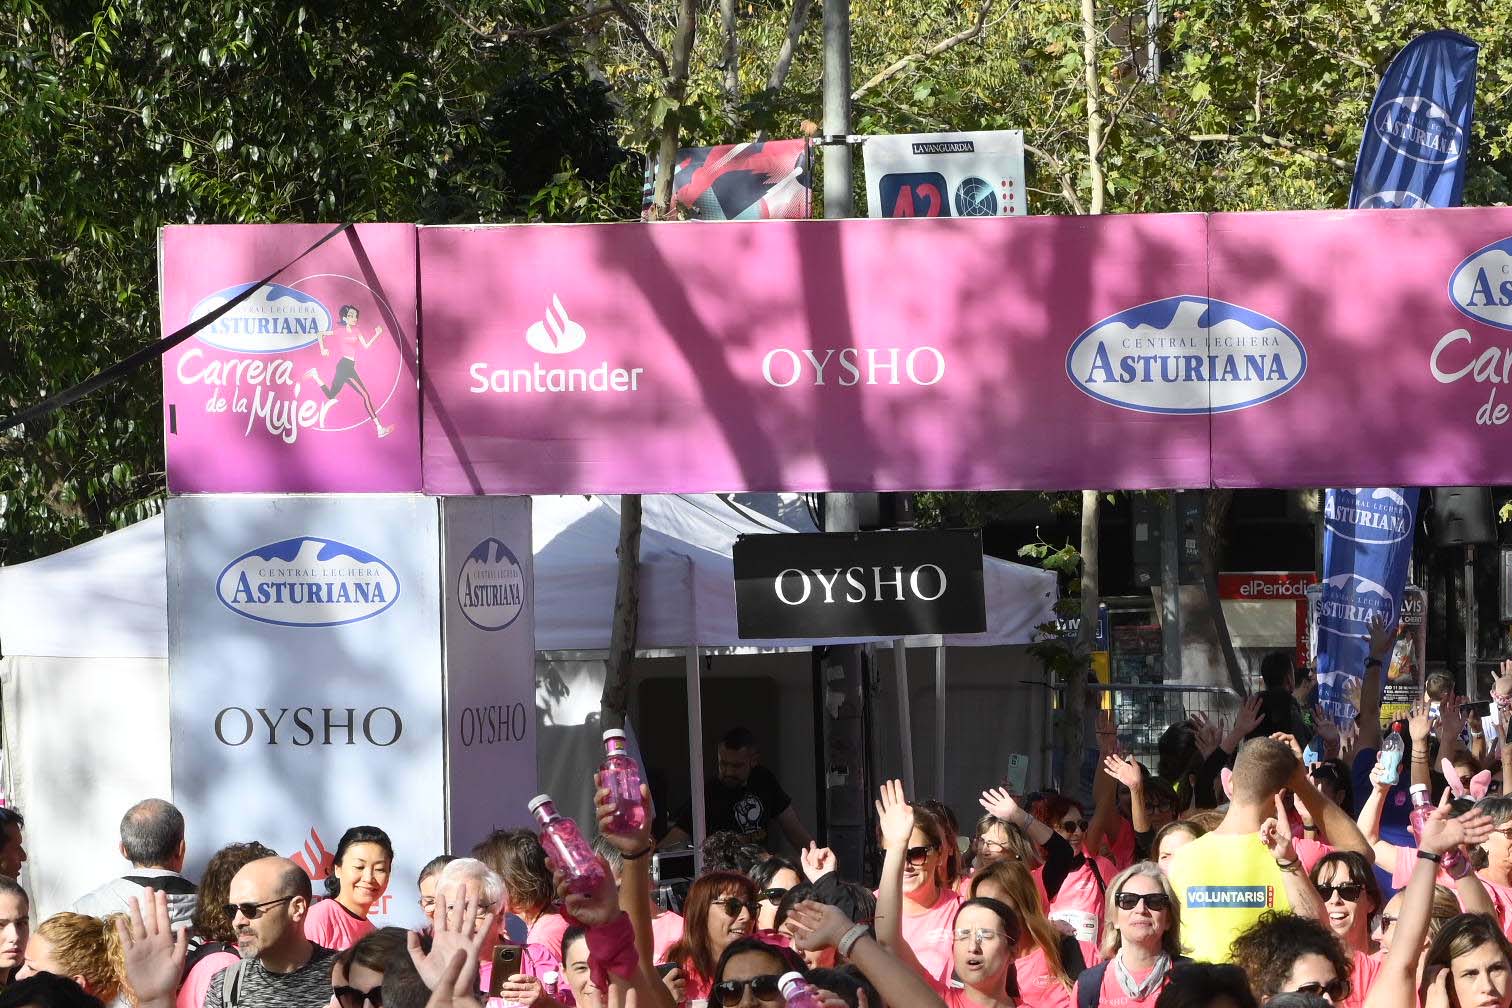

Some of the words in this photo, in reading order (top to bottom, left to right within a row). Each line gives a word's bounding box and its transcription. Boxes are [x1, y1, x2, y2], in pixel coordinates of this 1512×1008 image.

[1379, 107, 1458, 155] ASTURIANA
[1122, 337, 1200, 349] CENTRAL
[1204, 336, 1281, 348] LECHERA
[177, 349, 294, 385] Carrera
[469, 360, 643, 393] Santander
[761, 346, 946, 387] OYSHO
[1085, 342, 1289, 384] ASTURIANA
[206, 388, 227, 413] de
[232, 387, 248, 413] la
[245, 382, 338, 443] Mujer
[1476, 388, 1511, 426] de
[1324, 495, 1406, 534] ASTURIANA
[230, 570, 388, 604] ASTURIANA
[259, 568, 317, 578] CENTRAL
[323, 568, 381, 578] LECHERA
[462, 569, 521, 608] ASTURIANA
[774, 564, 948, 606] OYSHO
[1240, 579, 1310, 596] elPeriódi
[214, 706, 403, 748] OYSHO
[459, 702, 527, 748] OYSHO
[1187, 891, 1265, 903] VOLUNTARIS
